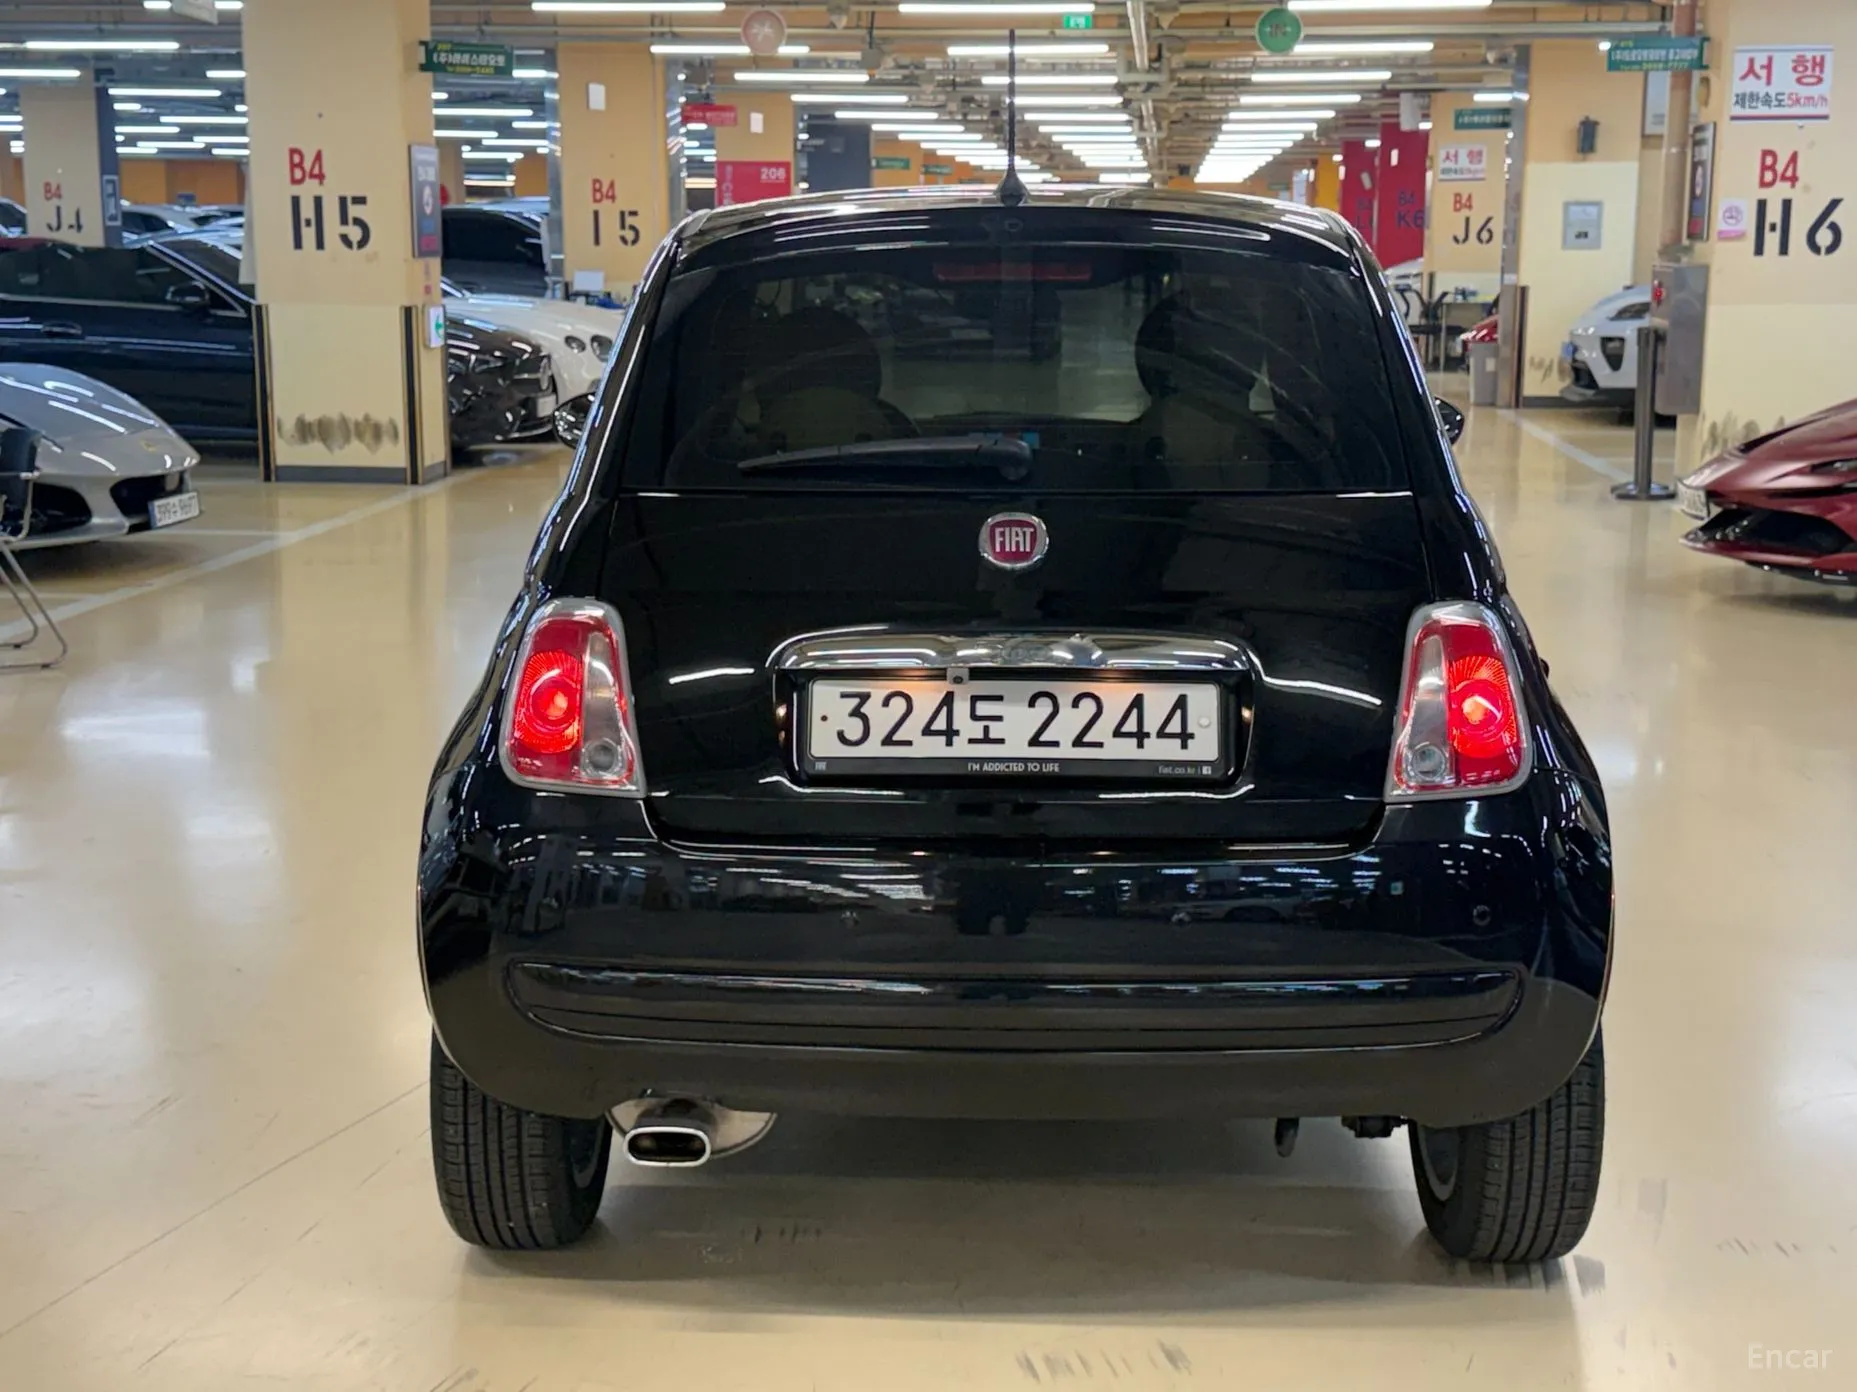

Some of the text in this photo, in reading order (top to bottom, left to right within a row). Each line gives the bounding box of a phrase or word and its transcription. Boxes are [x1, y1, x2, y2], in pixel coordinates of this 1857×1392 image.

[288, 147, 326, 186] B4
[1759, 149, 1799, 189] B4
[43, 181, 62, 201] B4
[592, 178, 616, 204] B4
[1453, 192, 1474, 213] B4
[1396, 209, 1425, 229] K6
[995, 526, 1035, 553] FIAT
[836, 690, 1195, 750] 324도 2244
[967, 762, 1060, 773] I'M ADDICTED TO LIFE
